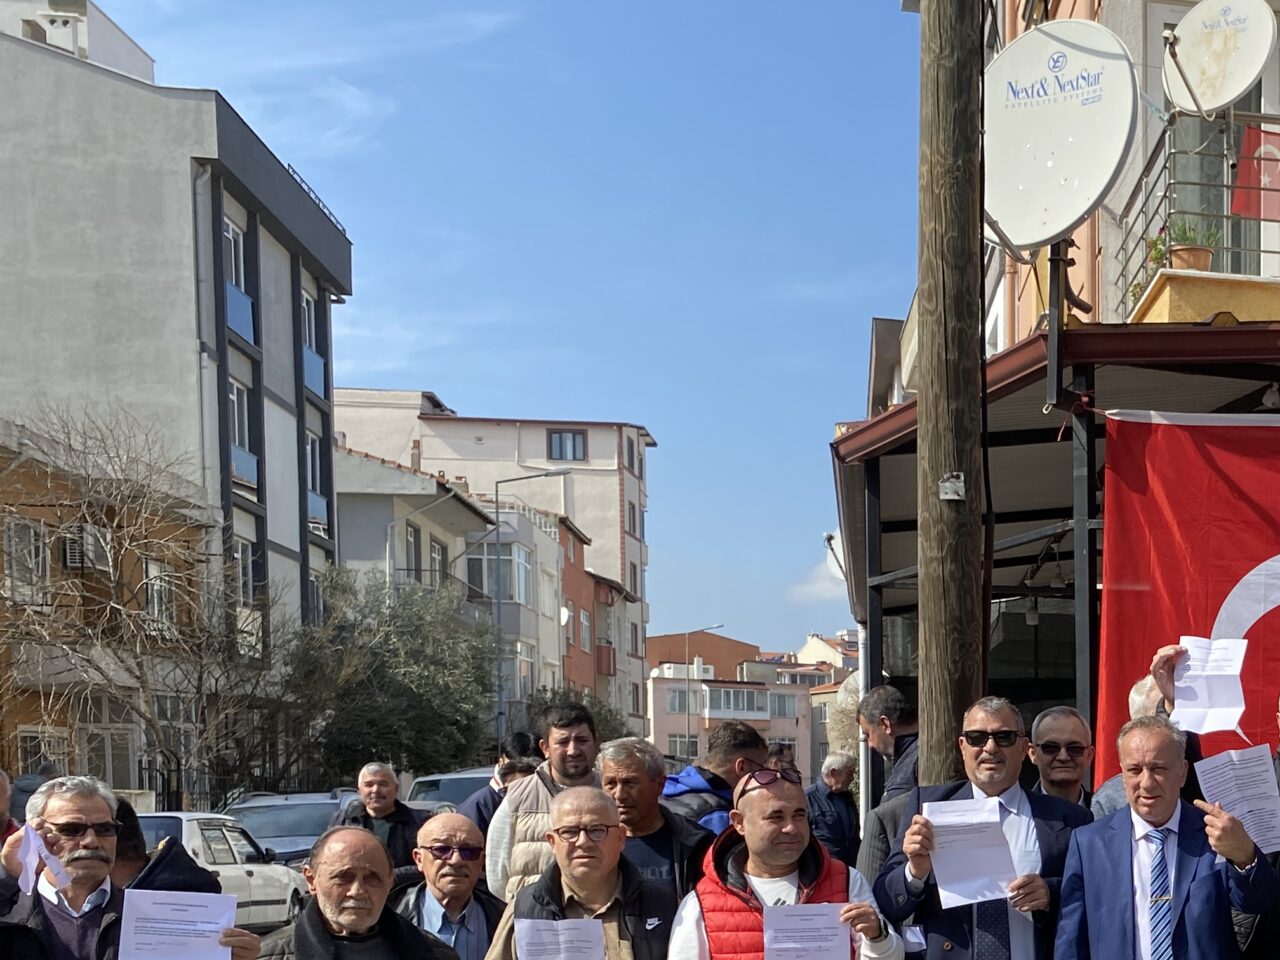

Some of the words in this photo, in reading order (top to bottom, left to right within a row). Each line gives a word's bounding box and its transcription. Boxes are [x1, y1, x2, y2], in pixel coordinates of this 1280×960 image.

[1007, 80, 1036, 101] Next
[1037, 77, 1048, 98] &
[1053, 68, 1103, 95] NextStar
